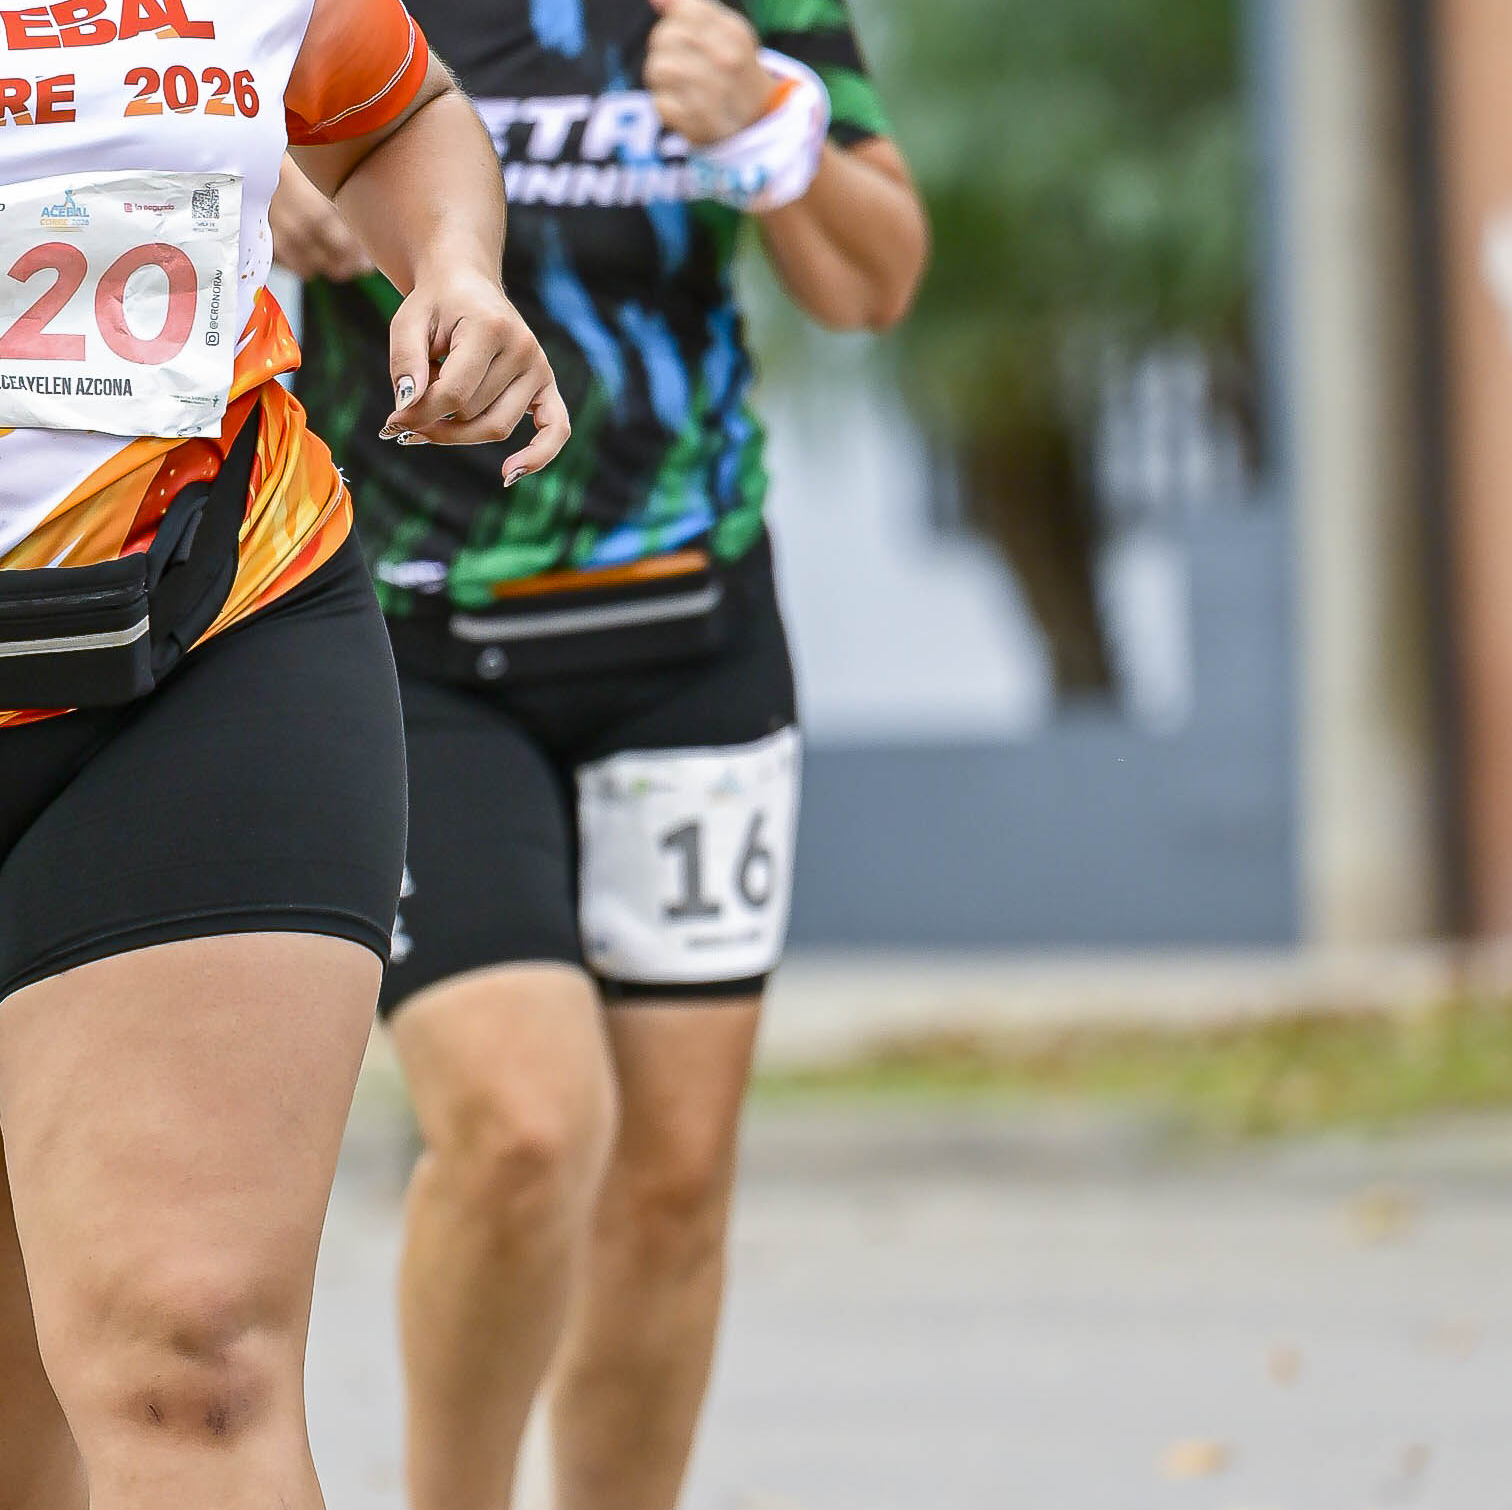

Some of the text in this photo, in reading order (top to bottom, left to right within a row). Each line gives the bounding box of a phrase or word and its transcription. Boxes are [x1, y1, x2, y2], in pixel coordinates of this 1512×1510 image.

[123, 65, 260, 119] 2026
[41, 204, 90, 217] ACEBAL
[75, 377, 133, 397] AZCONA
